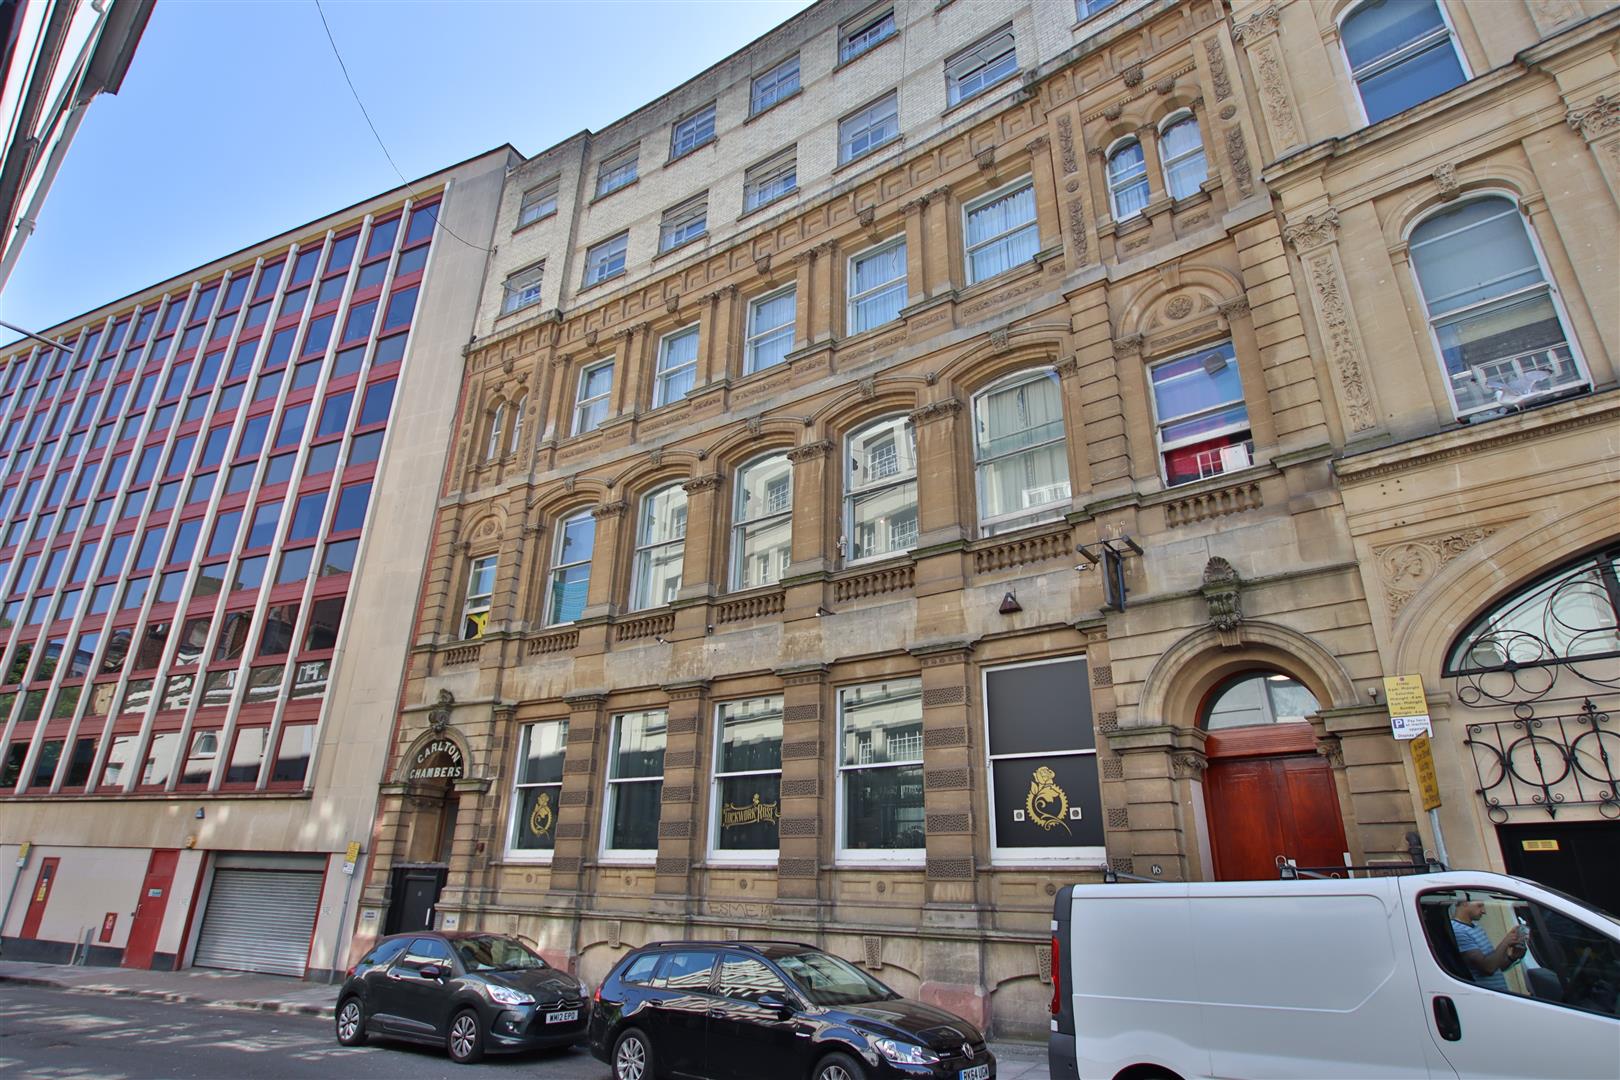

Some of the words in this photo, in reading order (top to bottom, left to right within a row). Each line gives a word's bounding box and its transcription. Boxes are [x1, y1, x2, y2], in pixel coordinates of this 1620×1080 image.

[417, 741, 461, 764] CARLTON
[409, 766, 461, 779] CHAMBERS
[1152, 865, 1162, 875] 16
